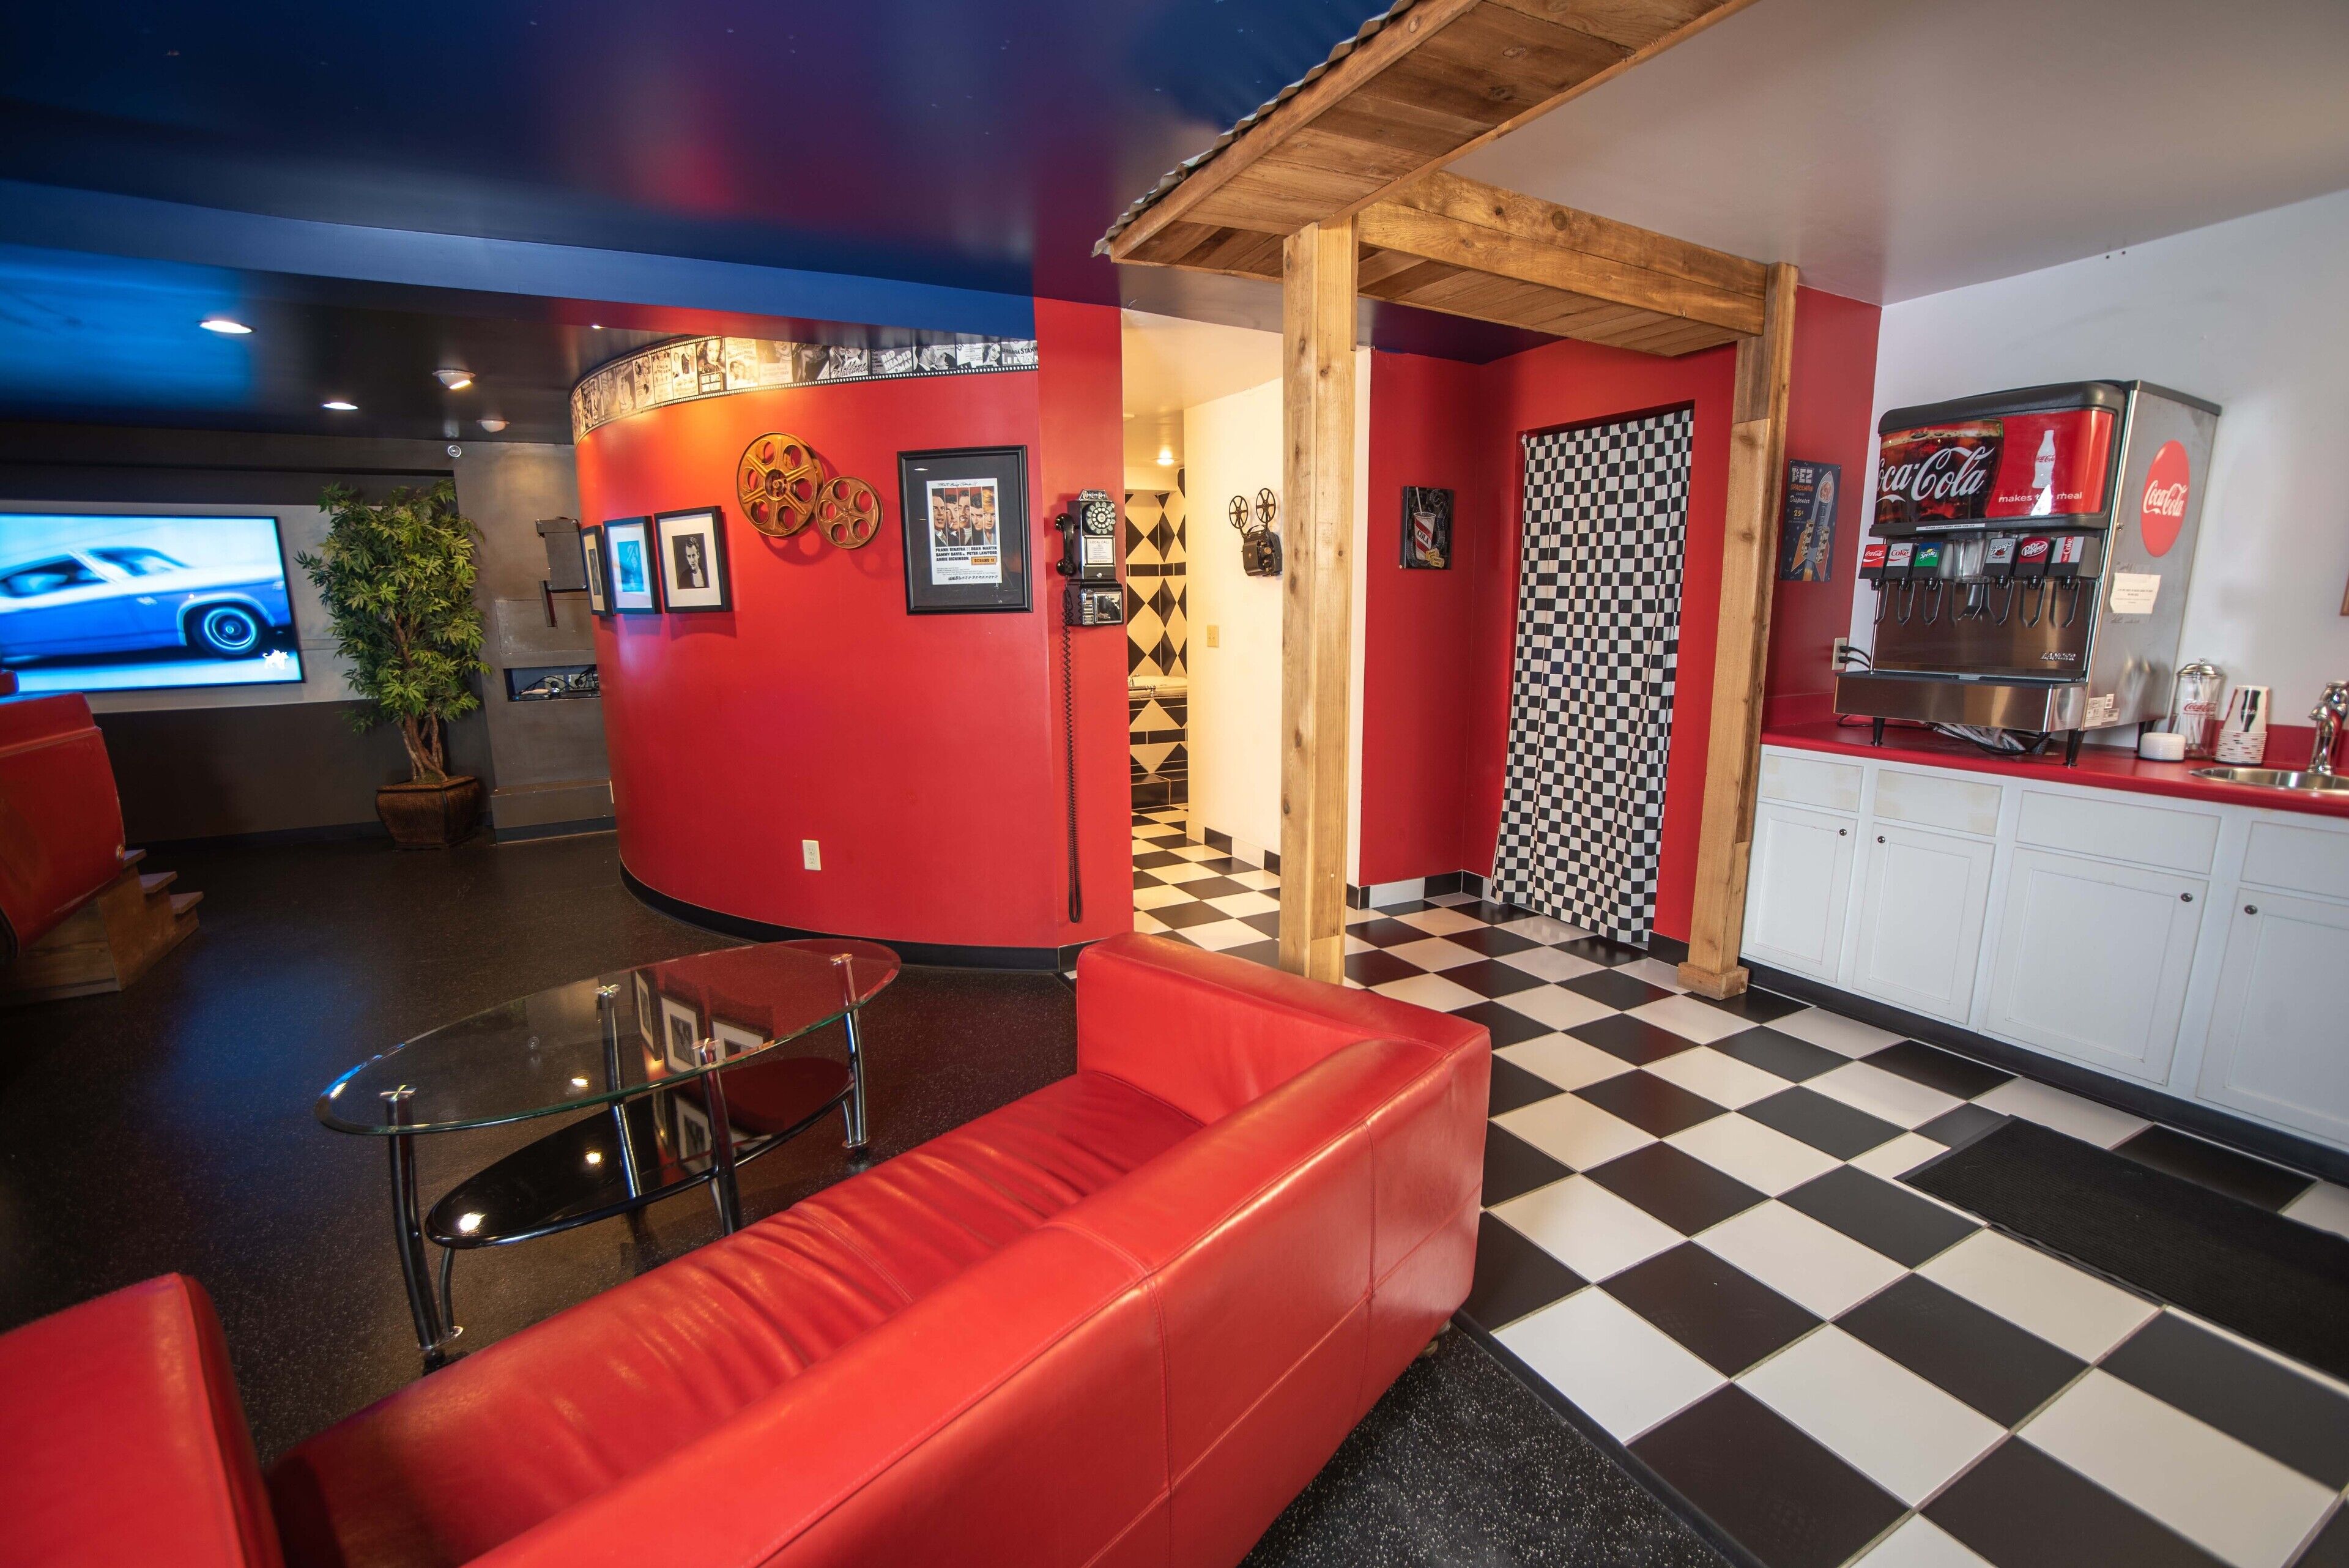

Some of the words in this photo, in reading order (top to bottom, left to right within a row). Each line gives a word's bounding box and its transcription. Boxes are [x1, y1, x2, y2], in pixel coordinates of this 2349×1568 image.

[881, 350, 895, 363] RED
[1792, 466, 1814, 484] PEZ
[1877, 446, 1995, 503] oca-Cola
[1790, 495, 1810, 504] Dispenser
[2143, 480, 2188, 516] Coca-Cola
[1417, 530, 1429, 544] COLA
[2024, 544, 2046, 556] Pepper
[2063, 538, 2074, 554] Coke
